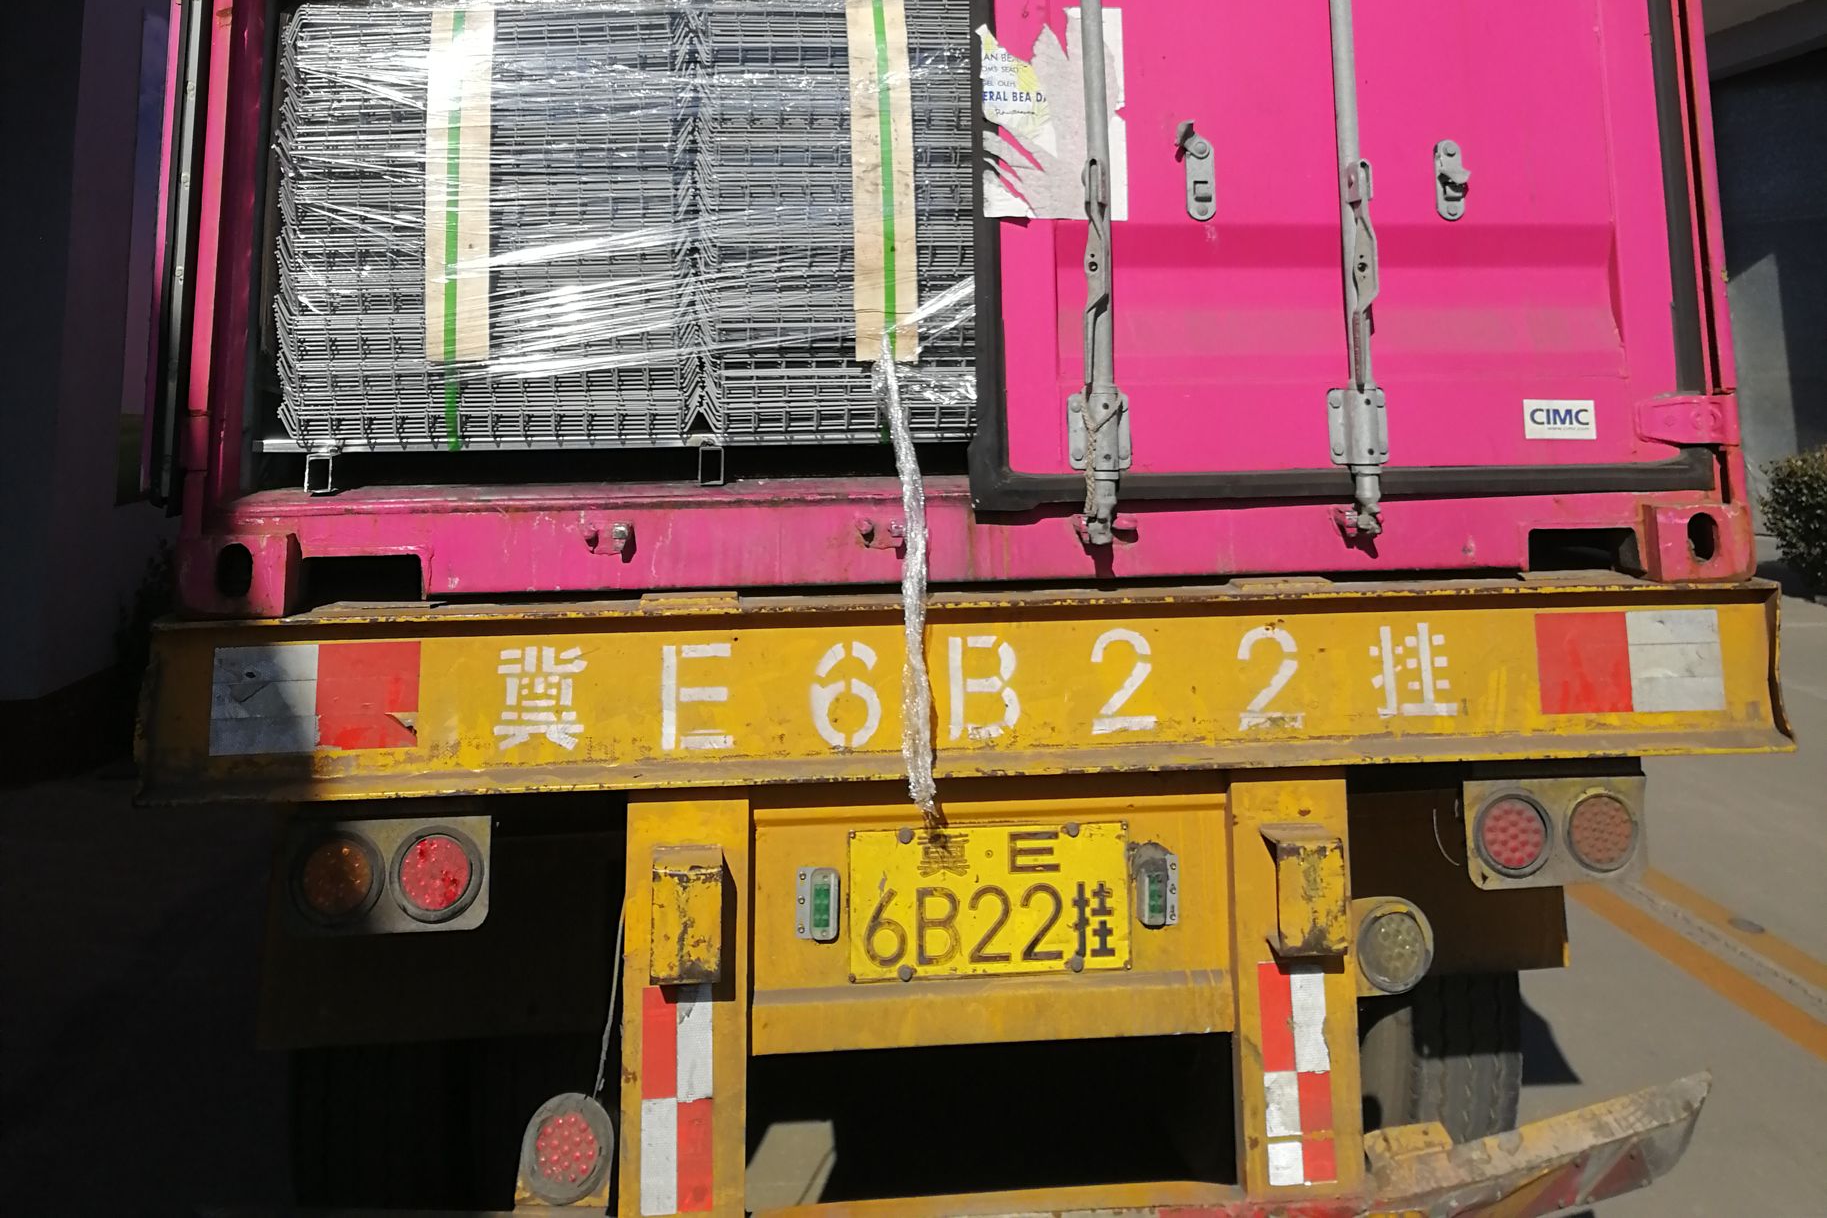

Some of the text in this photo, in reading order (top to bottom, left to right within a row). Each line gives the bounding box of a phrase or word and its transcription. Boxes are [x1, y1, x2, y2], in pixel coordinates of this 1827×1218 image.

[1012, 92, 1031, 102] BEA
[1530, 408, 1590, 426] CIMC
[864, 881, 1116, 967] 6B22挂
